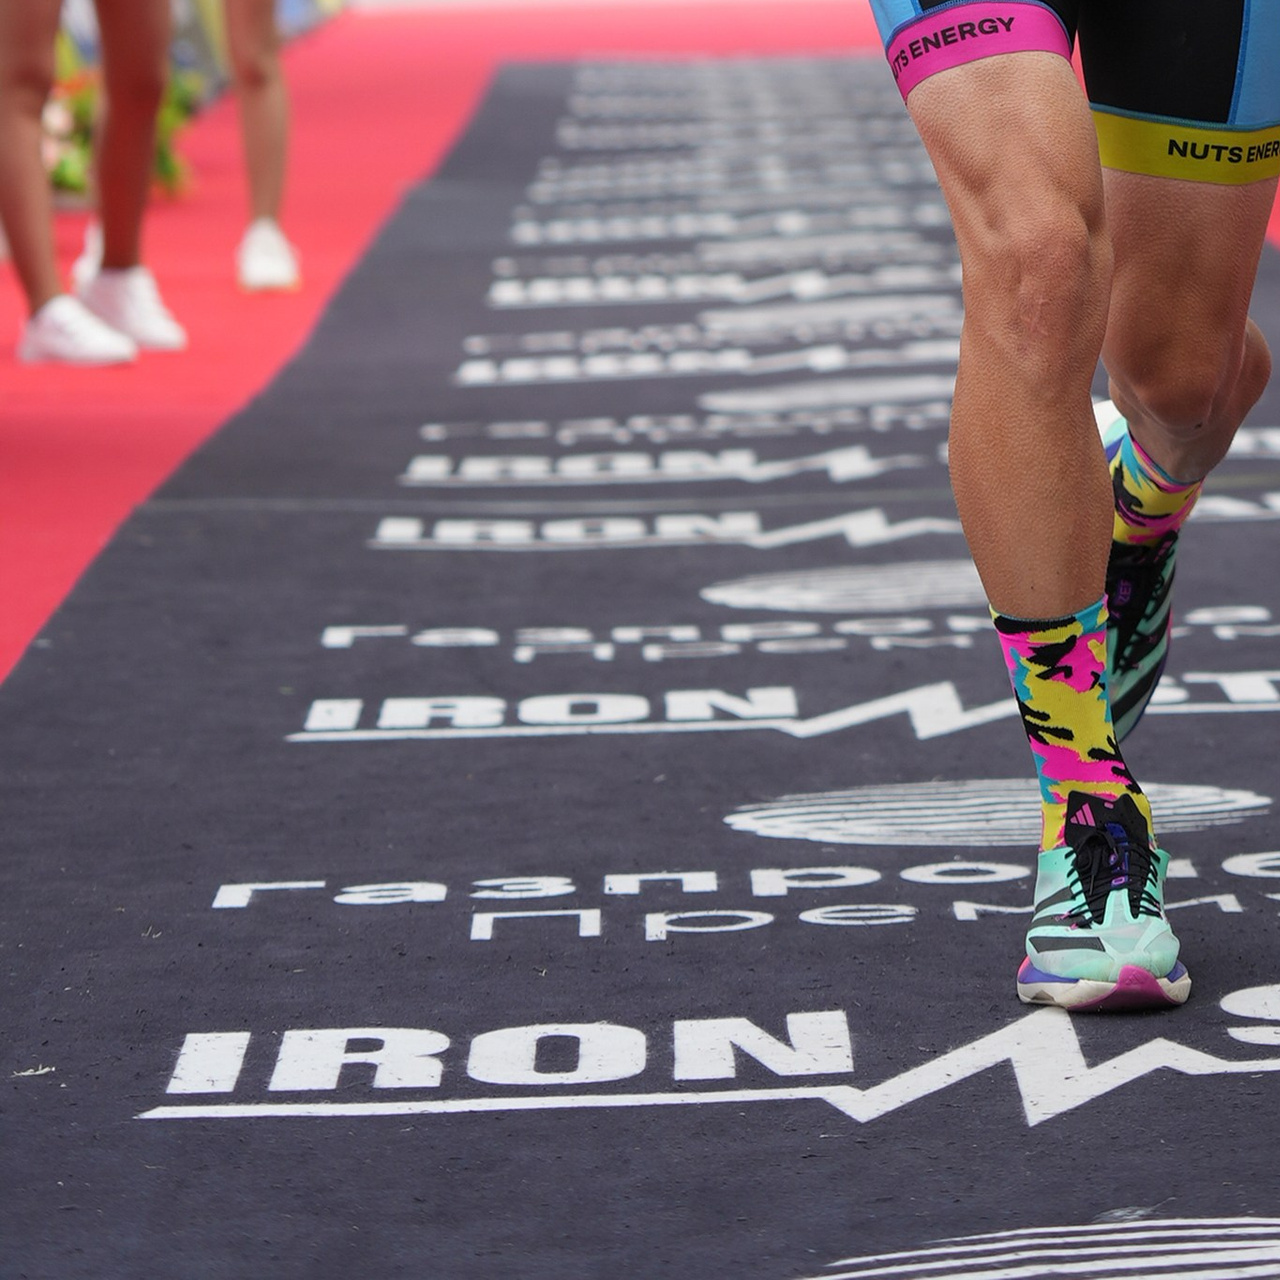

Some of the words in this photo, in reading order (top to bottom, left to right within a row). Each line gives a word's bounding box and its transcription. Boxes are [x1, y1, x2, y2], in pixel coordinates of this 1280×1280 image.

[908, 16, 1016, 60] ENERGY
[1167, 139, 1244, 163] NUTS
[304, 687, 798, 731] IRON
[165, 1009, 855, 1094] IRON
